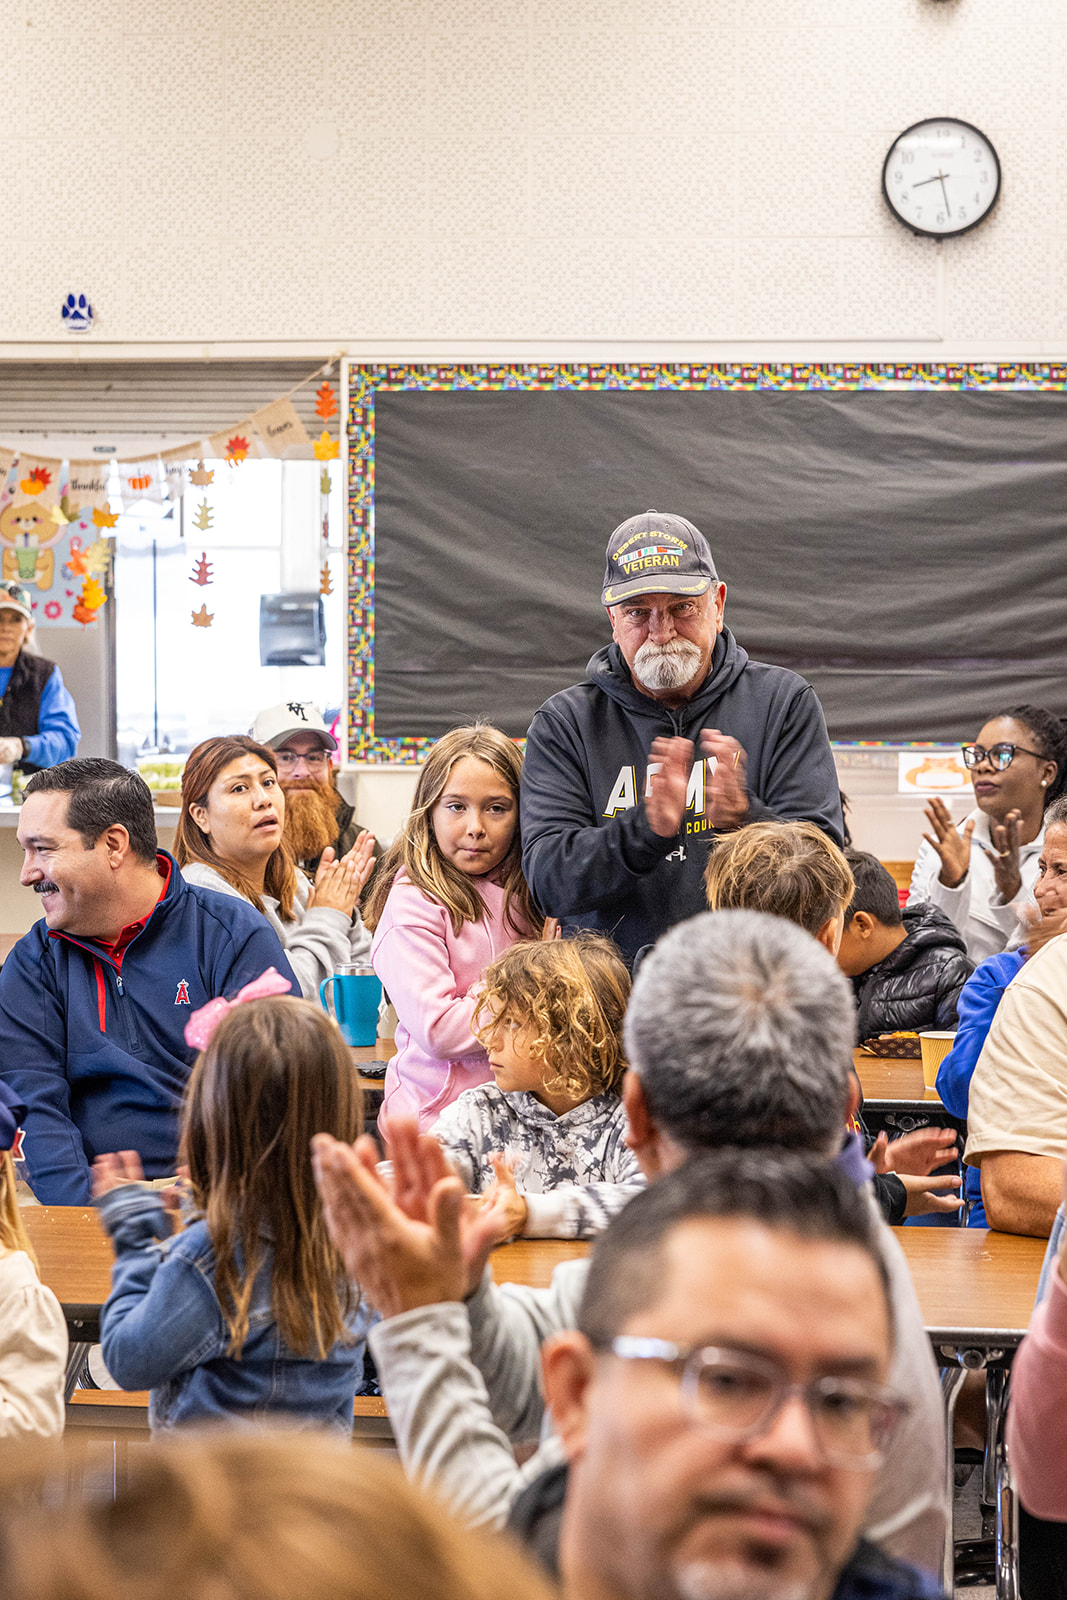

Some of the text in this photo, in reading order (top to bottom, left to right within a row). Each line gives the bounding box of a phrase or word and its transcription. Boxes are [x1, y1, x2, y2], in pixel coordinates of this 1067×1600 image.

[612, 530, 688, 561] DESERT STORM
[623, 554, 680, 575] VETERAN
[174, 978, 191, 1005] A
